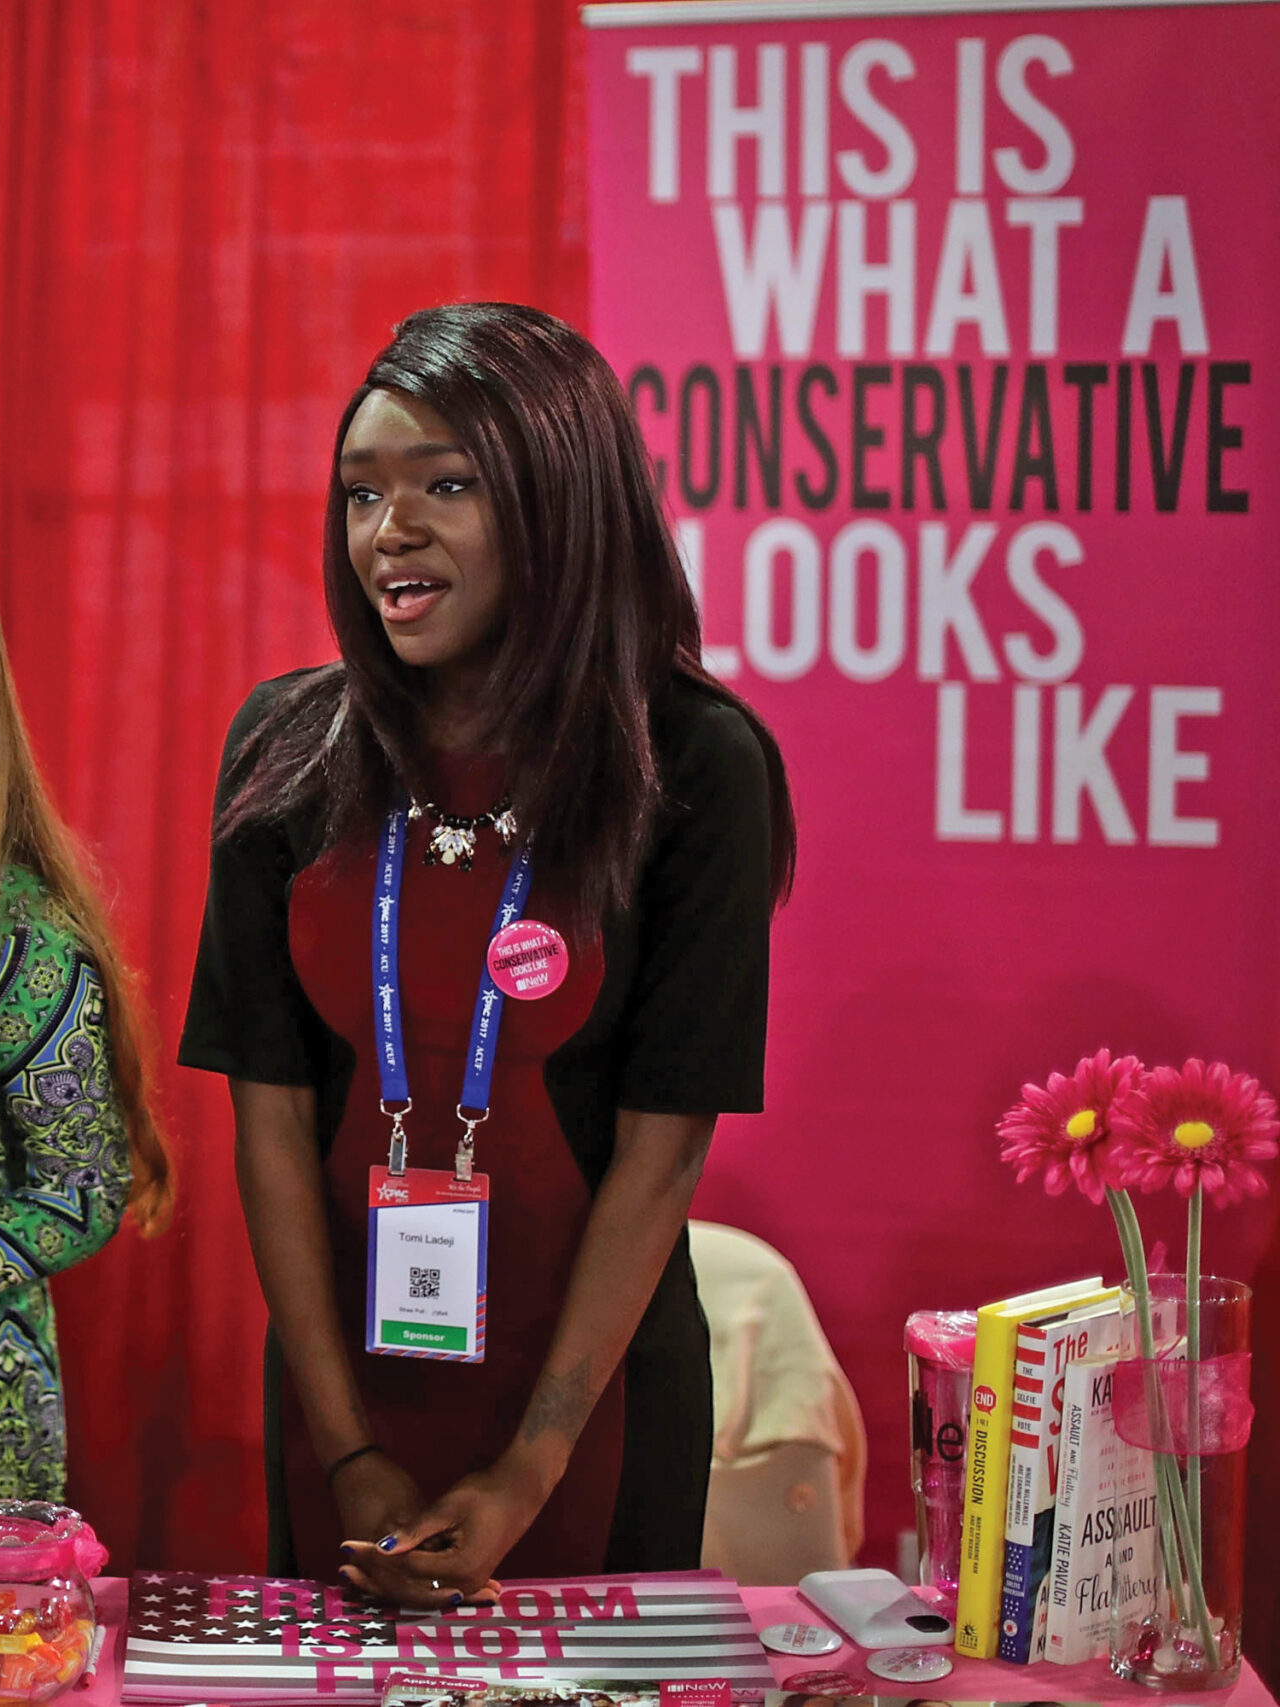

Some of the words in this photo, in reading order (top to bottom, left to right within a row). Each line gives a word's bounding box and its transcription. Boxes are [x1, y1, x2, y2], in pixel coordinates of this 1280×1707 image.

[626, 37, 916, 203] THIS
[956, 33, 1075, 196] IS
[711, 197, 1083, 359] WHAT
[1121, 195, 1210, 356] A
[628, 361, 1251, 514] CONSERVATIVE
[674, 517, 1084, 684] LOOKS
[935, 682, 1222, 847] LIKE
[493, 944, 559, 971] CONSERVATIVE
[497, 944, 513, 957] THIS
[513, 942, 521, 953] IS
[520, 937, 541, 951] WHAT
[542, 935, 549, 945] A
[509, 963, 533, 977] LOOKS
[532, 958, 549, 971] LIKE
[525, 972, 549, 987] NeW
[399, 1231, 423, 1244] Tomi
[425, 1234, 455, 1249] Ladeji
[403, 1330, 445, 1342] Sponsor
[1053, 1330, 1088, 1376] The
[1022, 1366, 1033, 1377] THE
[975, 1391, 995, 1408] END
[1016, 1392, 1037, 1405] SELFIE
[1017, 1420, 1031, 1432] VOTE
[1069, 1403, 1082, 1447] ASSAULT
[971, 1429, 988, 1505] DISCUSSION
[1069, 1449, 1077, 1465] AND
[1058, 1523, 1073, 1558] KATIE
[1053, 1559, 1070, 1608] PAVLICH
[207, 1583, 641, 1621] FREOM
[281, 1623, 363, 1658] IS
[395, 1625, 576, 1659] NOT
[402, 1677, 437, 1687] Apply
[439, 1680, 480, 1689] Today!
[685, 1682, 726, 1692] NeW
